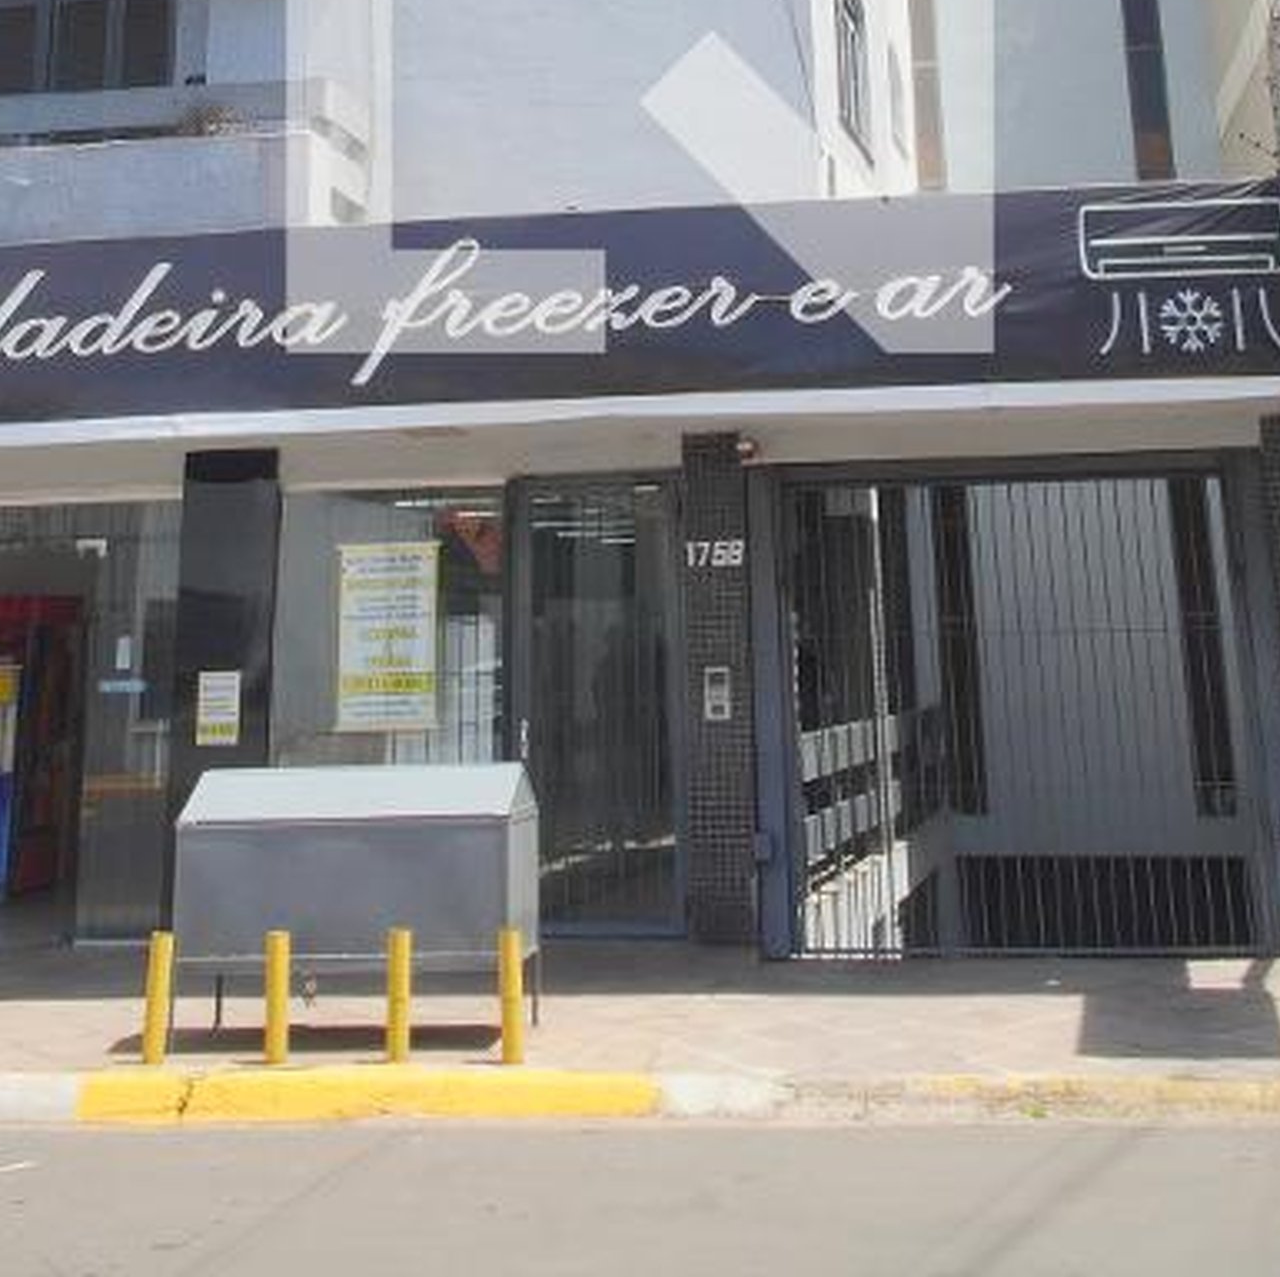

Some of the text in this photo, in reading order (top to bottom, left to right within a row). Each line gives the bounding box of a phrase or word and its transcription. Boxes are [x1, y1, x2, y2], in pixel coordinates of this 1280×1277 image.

[350, 237, 760, 386] freezer
[789, 275, 858, 324] e
[874, 265, 1012, 320] ar
